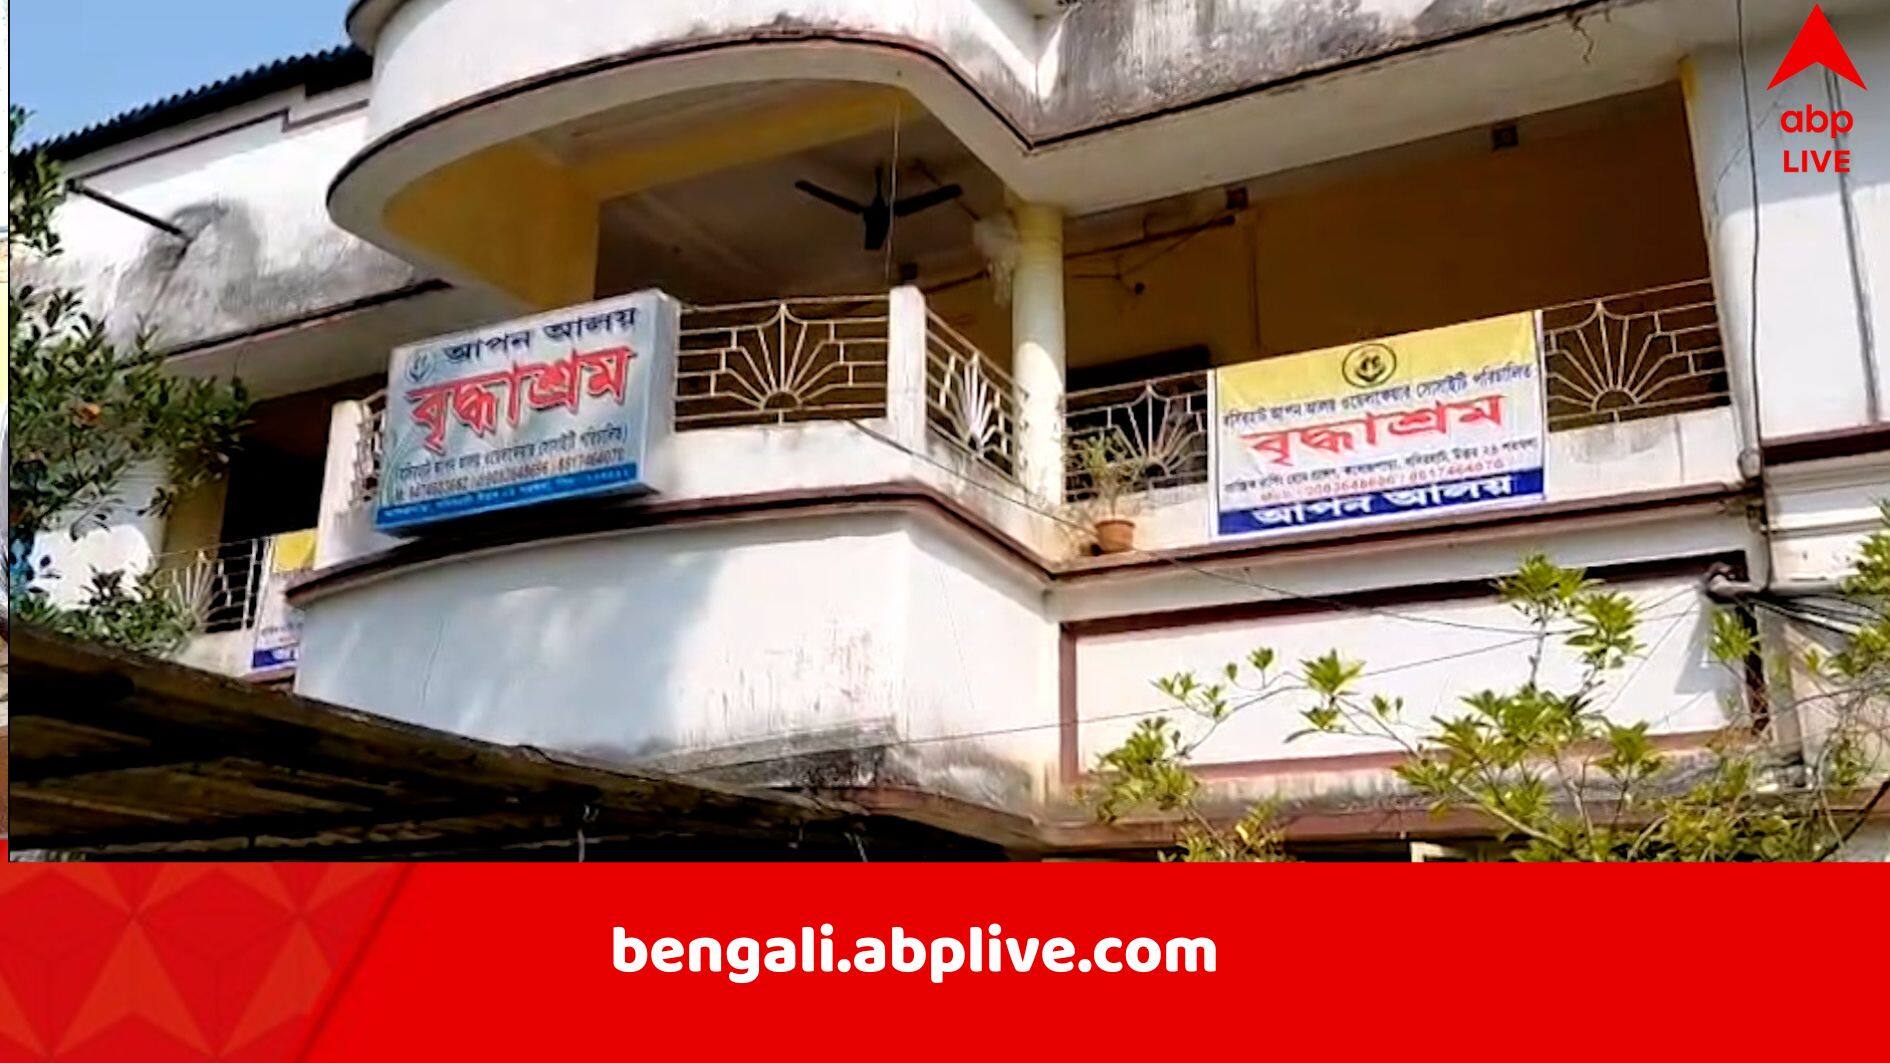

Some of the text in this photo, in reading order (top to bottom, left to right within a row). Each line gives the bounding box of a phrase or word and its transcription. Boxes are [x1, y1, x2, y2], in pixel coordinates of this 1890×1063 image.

[443, 306, 638, 364] আপন আলয়
[405, 346, 638, 457] বৃদ্ধাশ্রম
[1239, 394, 1508, 467] বৃদ্ধাশ্রম
[1251, 474, 1513, 525] আপন আলয়
